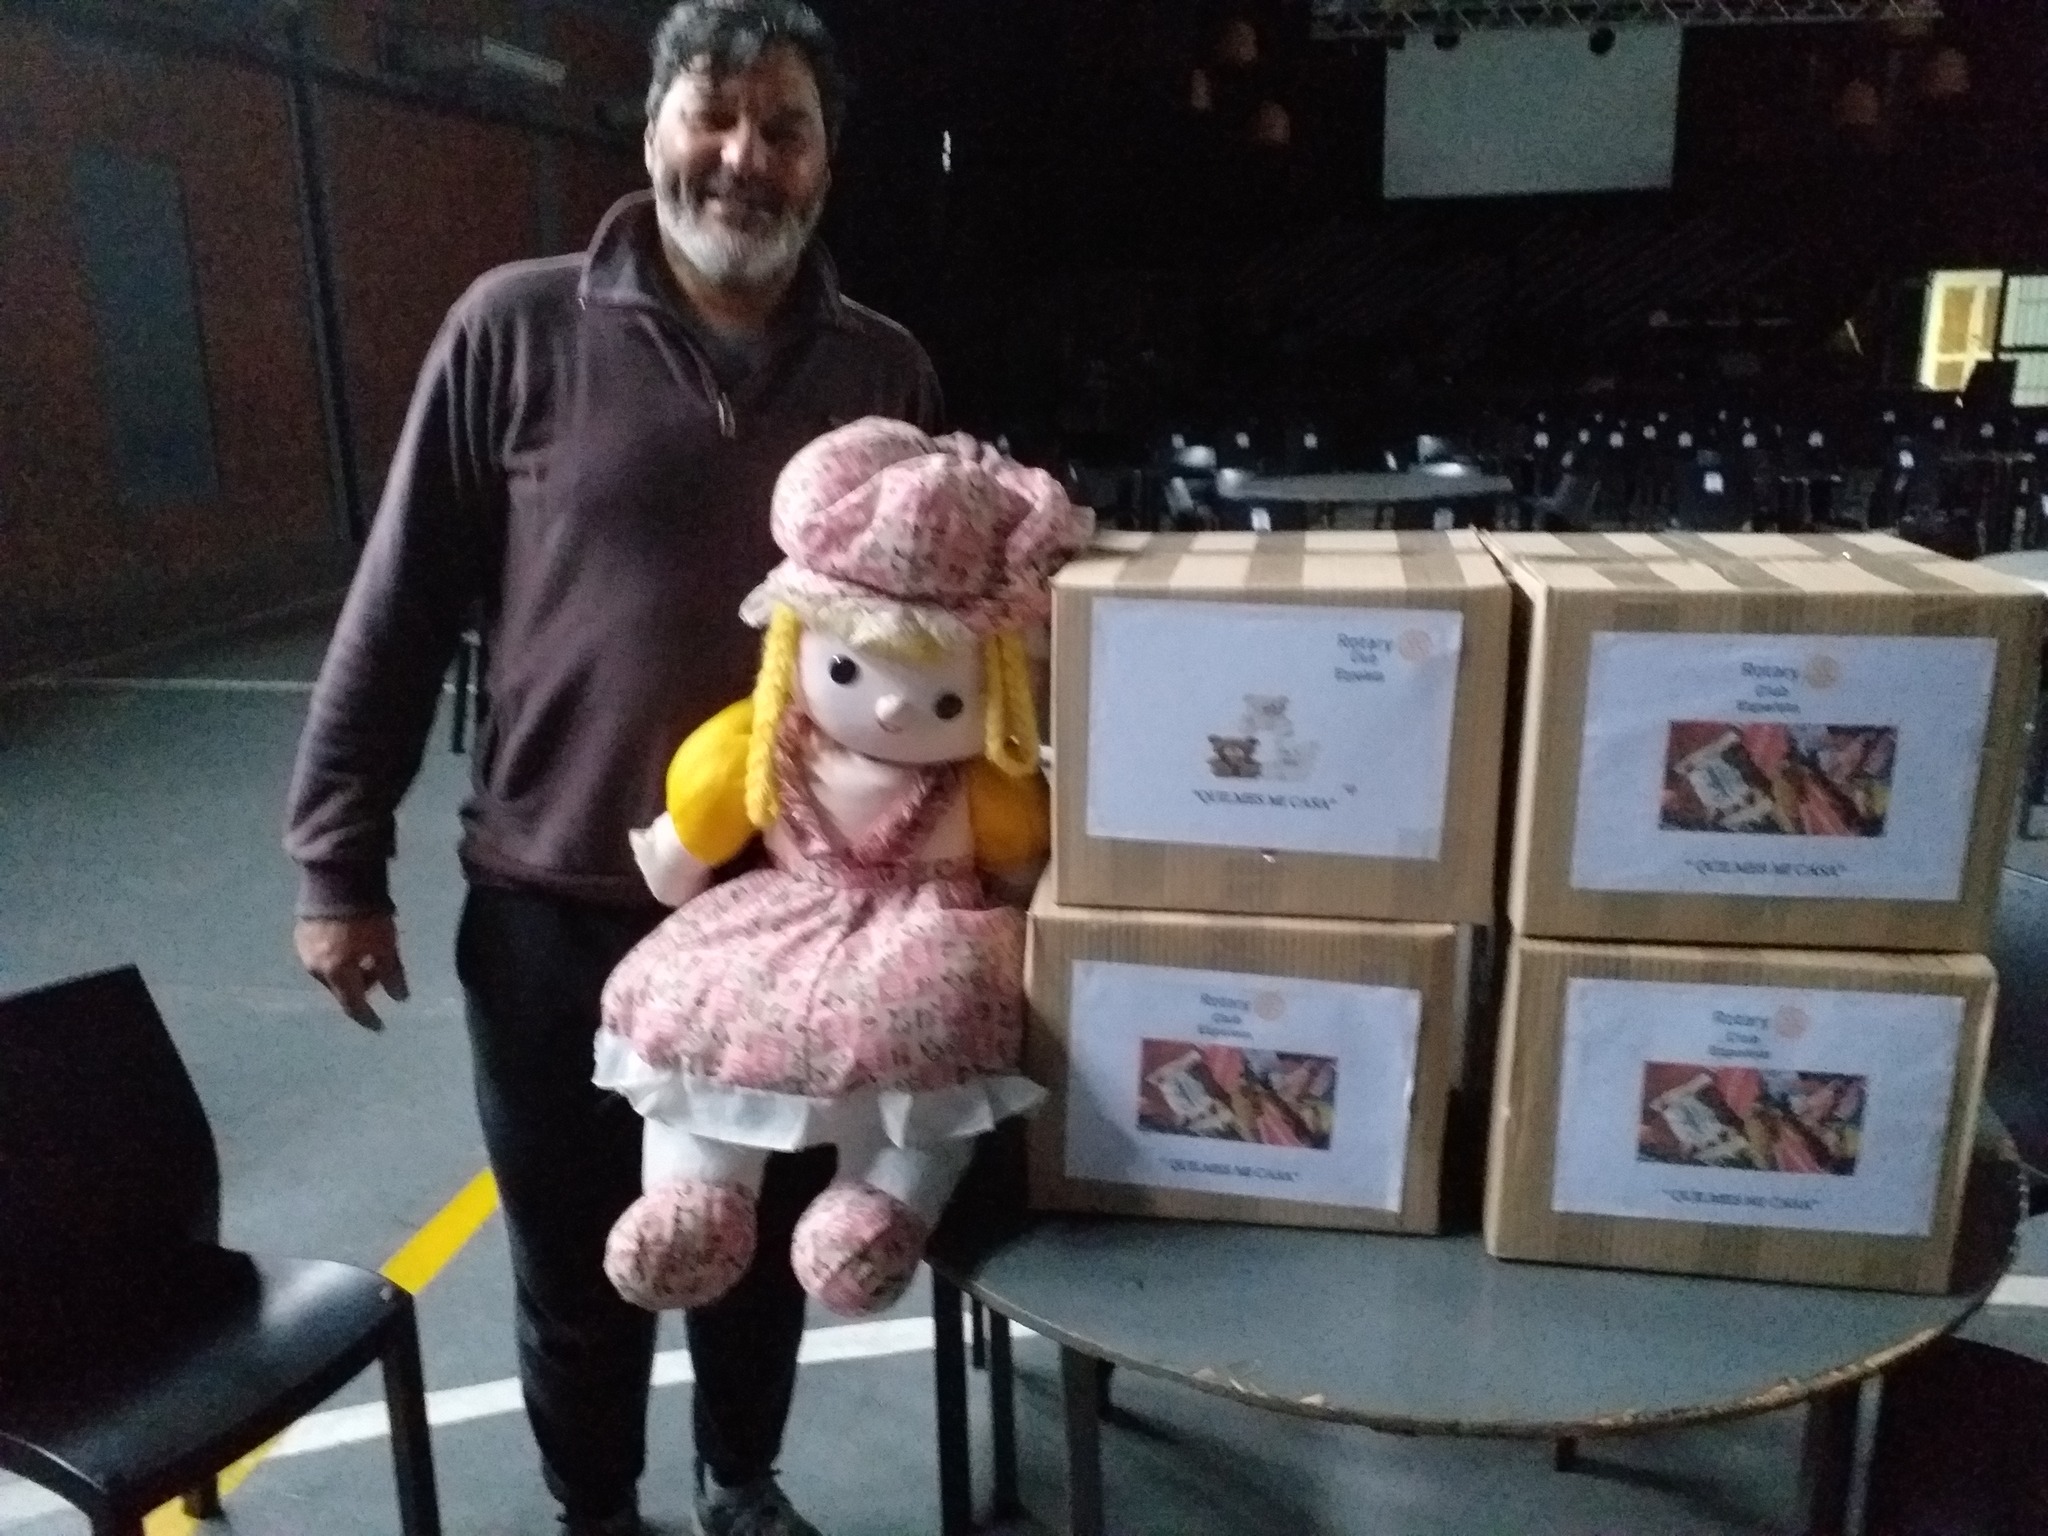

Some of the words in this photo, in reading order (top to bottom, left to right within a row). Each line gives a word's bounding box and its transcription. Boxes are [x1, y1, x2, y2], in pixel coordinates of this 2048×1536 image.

[1337, 633, 1393, 654] Rotary
[1741, 662, 1799, 681] Rotary
[1712, 1010, 1769, 1031] Rotary
